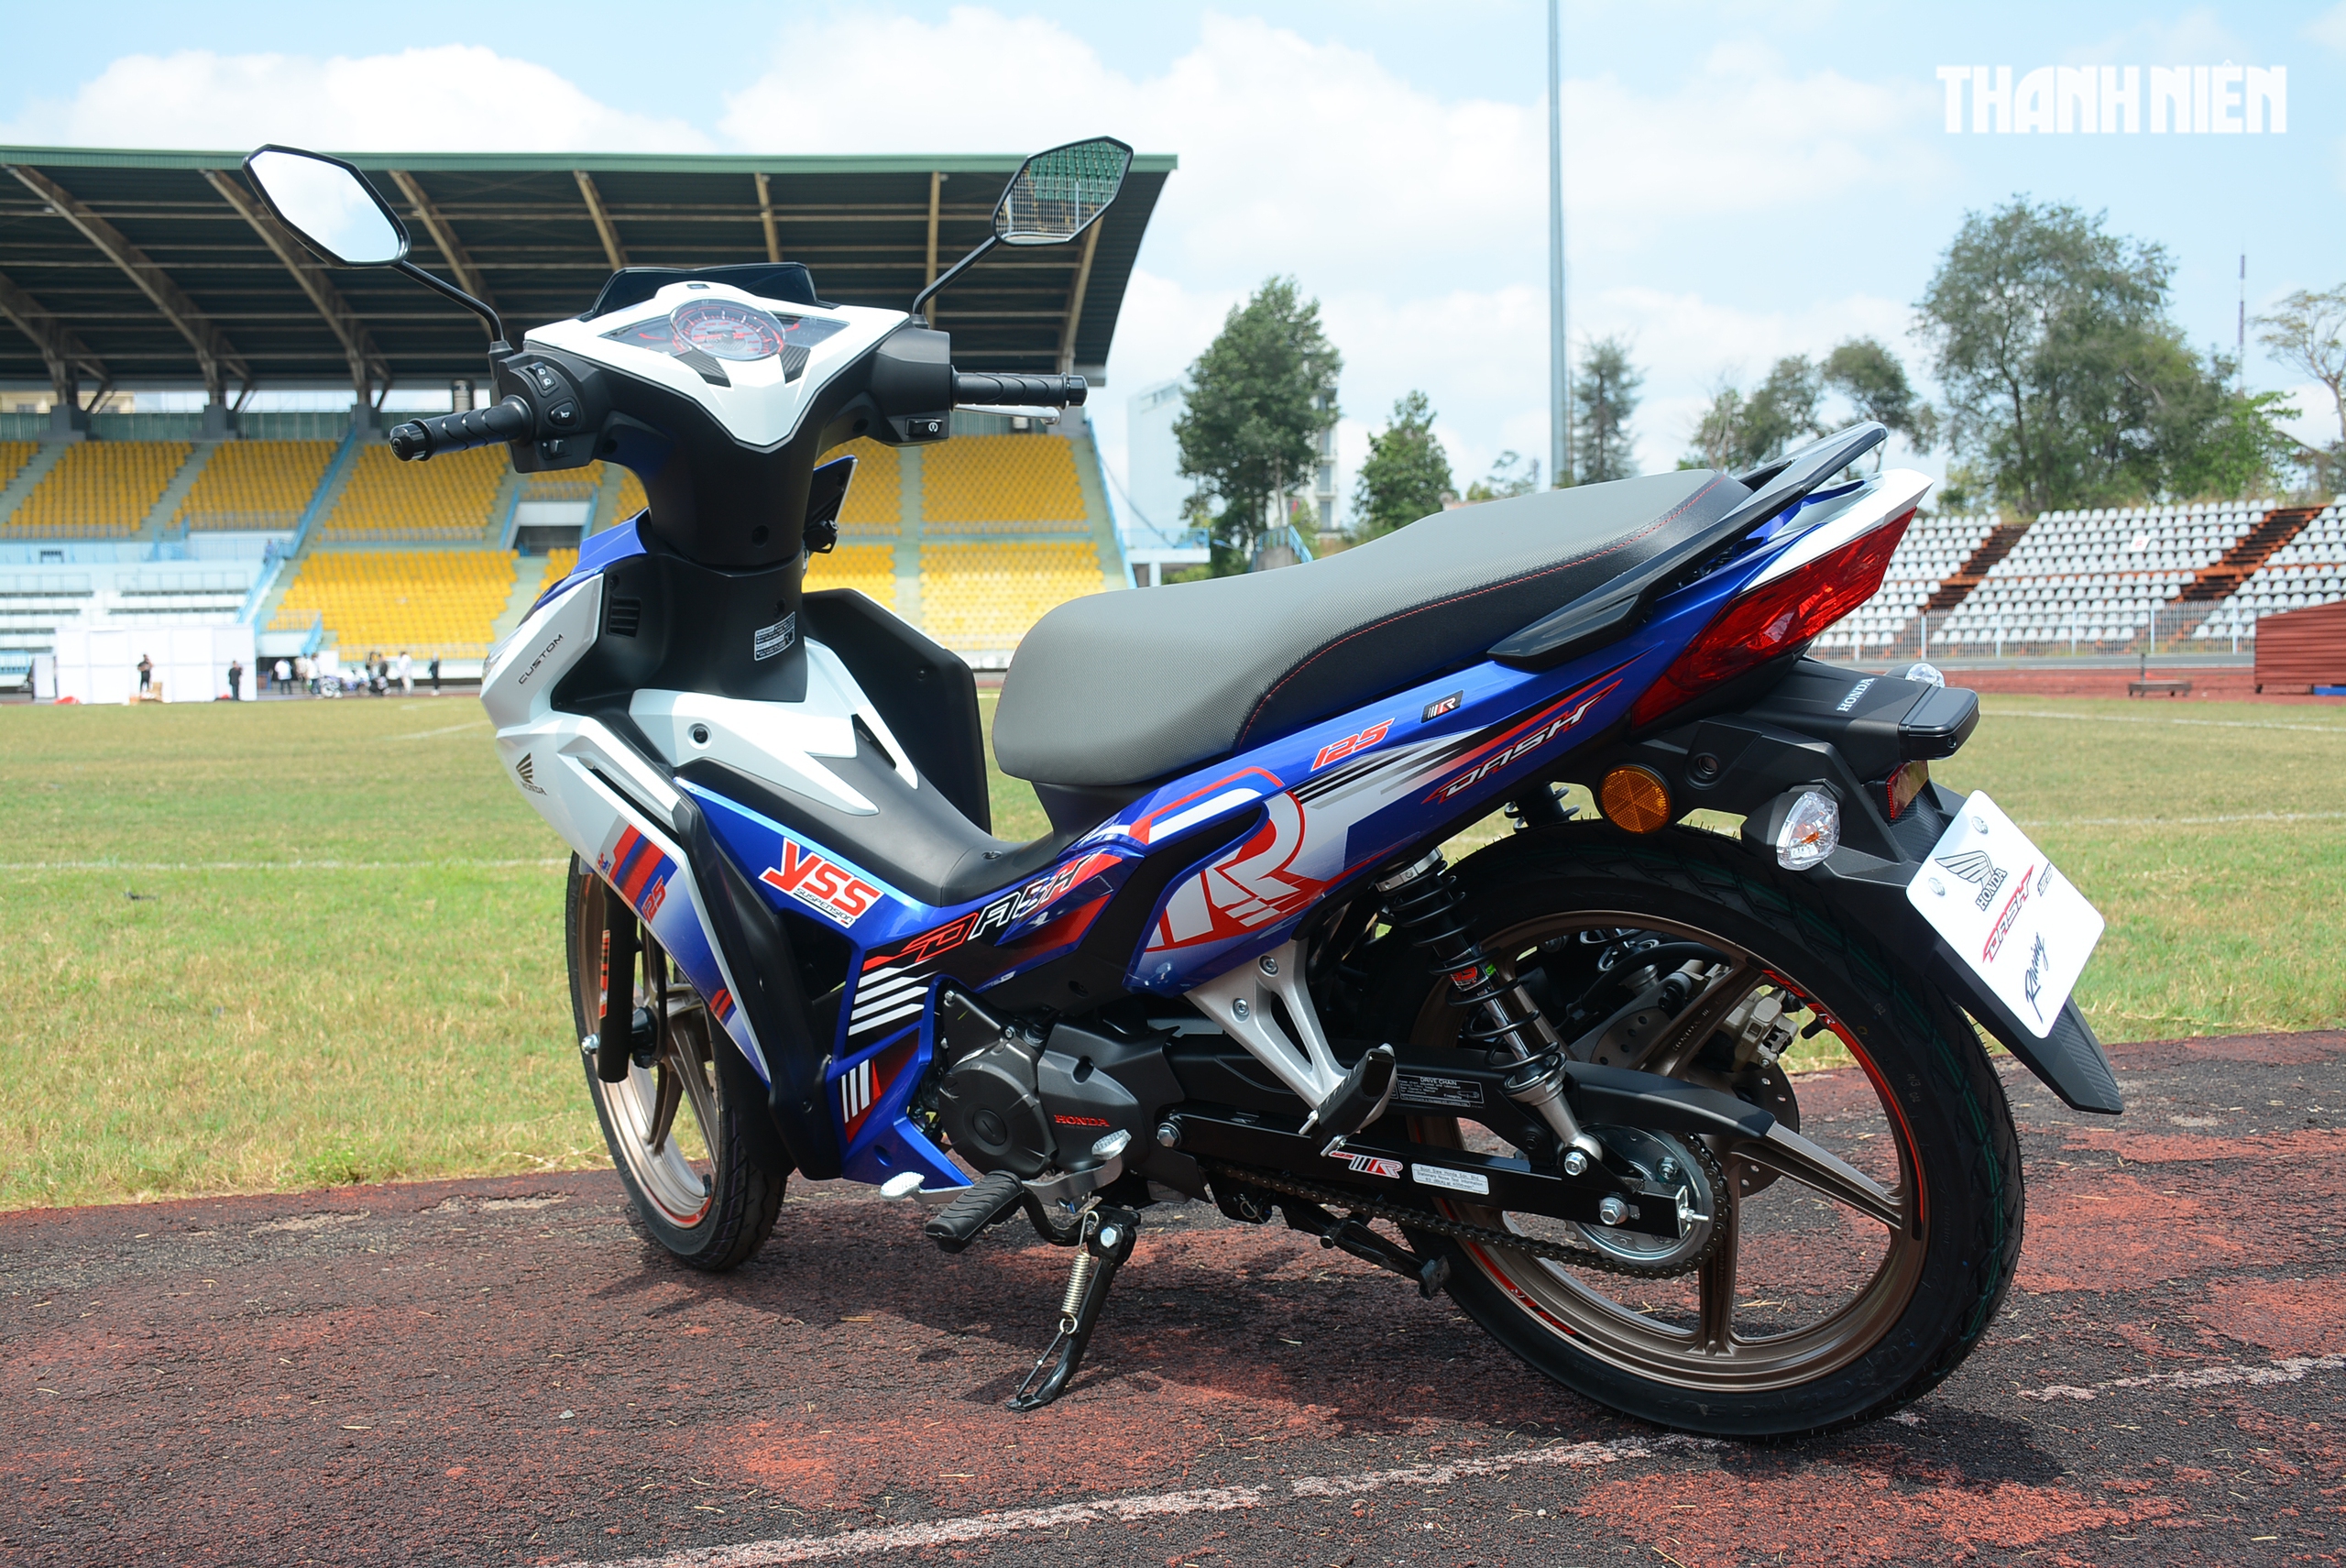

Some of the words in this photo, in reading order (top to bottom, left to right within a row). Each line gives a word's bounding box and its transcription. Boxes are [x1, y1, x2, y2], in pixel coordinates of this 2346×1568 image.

[518, 633, 564, 685] CUSTOM
[1836, 678, 1876, 712] HONDA
[1311, 718, 1395, 772] 125
[1431, 687, 1613, 800] DASH
[521, 780, 548, 796] HONDA
[641, 874, 667, 925] 125
[762, 840, 881, 917] YSS
[1975, 868, 2008, 911] HONDA
[795, 887, 854, 923] SUSPENSION
[900, 848, 1107, 963] DASH
[1982, 864, 2034, 963] DASH
[2037, 862, 2053, 897] 125
[1439, 1078, 1457, 1086] CHAIN
[1053, 1113, 1111, 1127] HONDA
